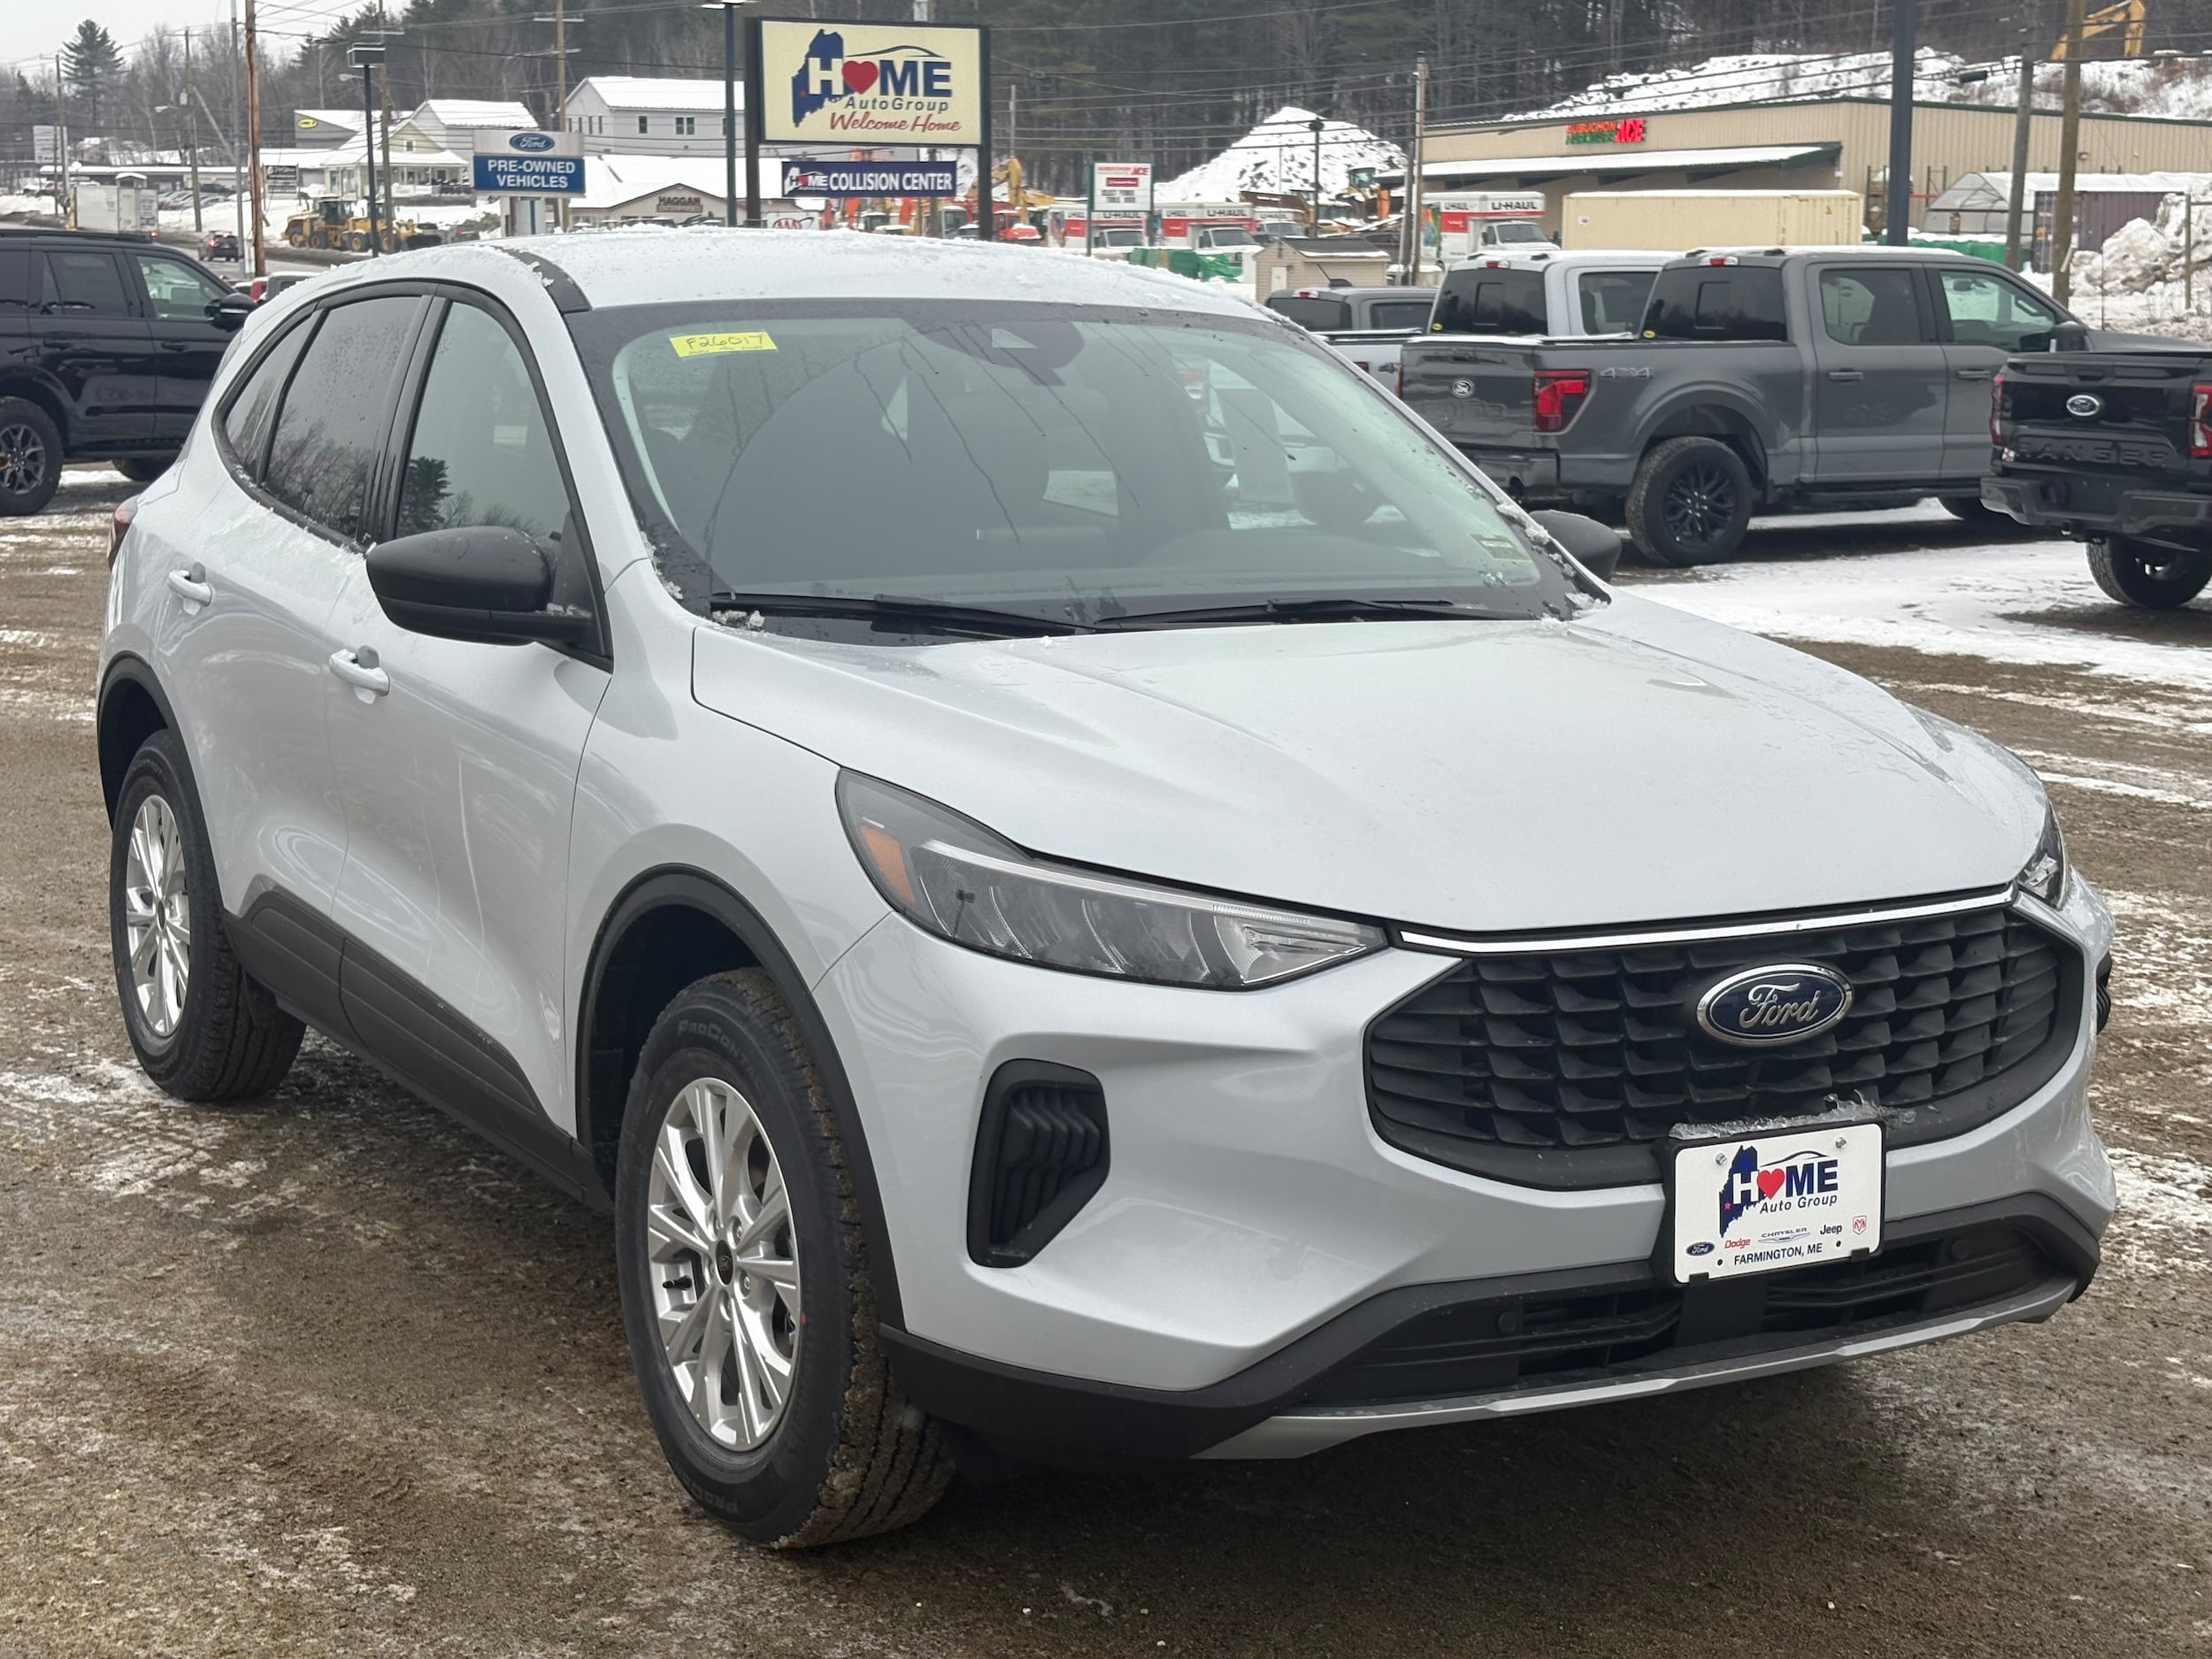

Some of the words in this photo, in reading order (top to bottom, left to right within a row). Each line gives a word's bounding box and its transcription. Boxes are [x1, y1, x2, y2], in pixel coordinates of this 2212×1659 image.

[844, 97, 949, 114] AutoGroup
[830, 111, 909, 130] Welcome
[910, 113, 962, 133] Home
[520, 136, 547, 148] Ford
[488, 159, 576, 173] PRE-OWNED
[496, 174, 569, 188] VEHICLES
[829, 173, 899, 190] COLLISION
[902, 173, 953, 190] CENTER
[687, 335, 764, 349] F26017
[2016, 442, 2168, 468] RANGER
[1739, 982, 1823, 1029] Ford
[1760, 1199, 1793, 1215] Auto
[1797, 1194, 1838, 1210] Group
[1691, 1243, 1709, 1255] Ford
[1724, 1239, 1751, 1249] Dodge
[1761, 1227, 1808, 1239] CHRYSLER
[1820, 1225, 1843, 1236] Jeep
[1734, 1247, 1805, 1266] FARMINGTON,
[1807, 1243, 1823, 1255] ME
